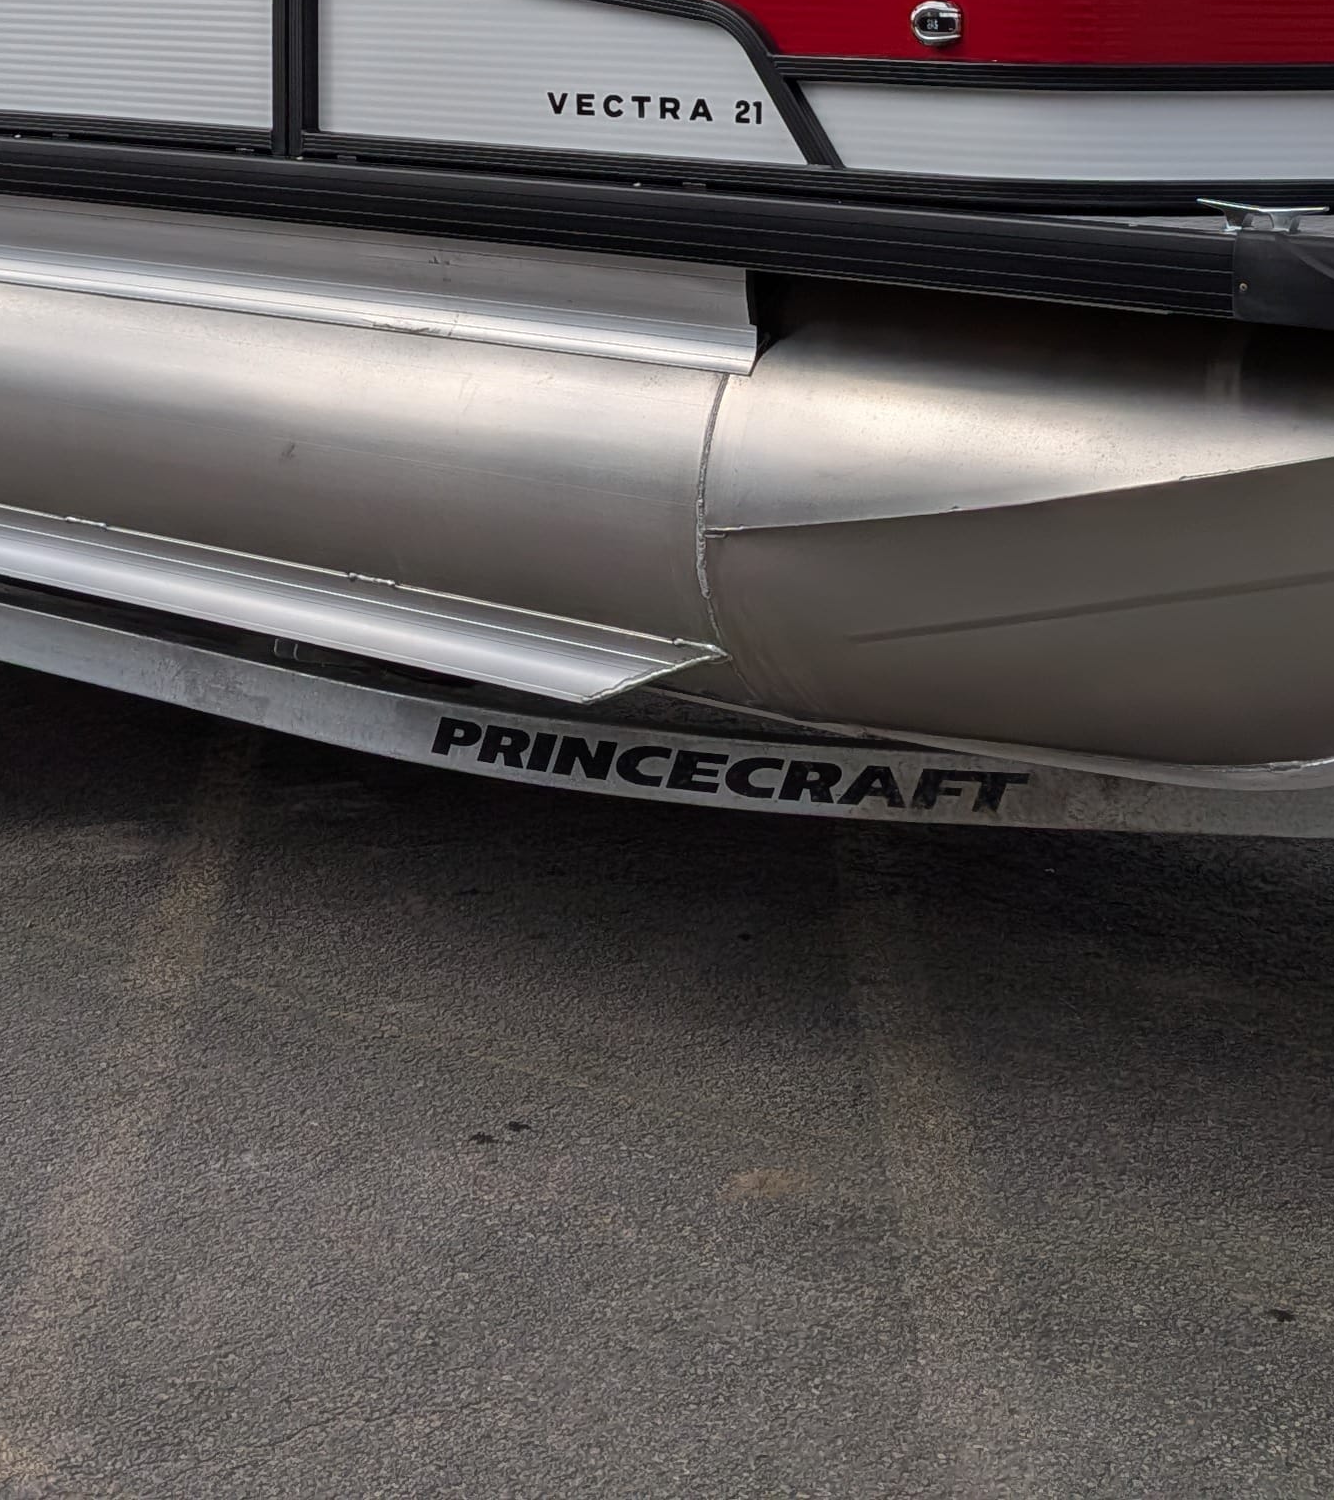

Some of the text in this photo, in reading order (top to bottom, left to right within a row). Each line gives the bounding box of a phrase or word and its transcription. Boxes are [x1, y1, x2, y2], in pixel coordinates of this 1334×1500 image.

[547, 92, 762, 124] VECTRA 21
[431, 716, 1029, 814] PRINCECRAFT
